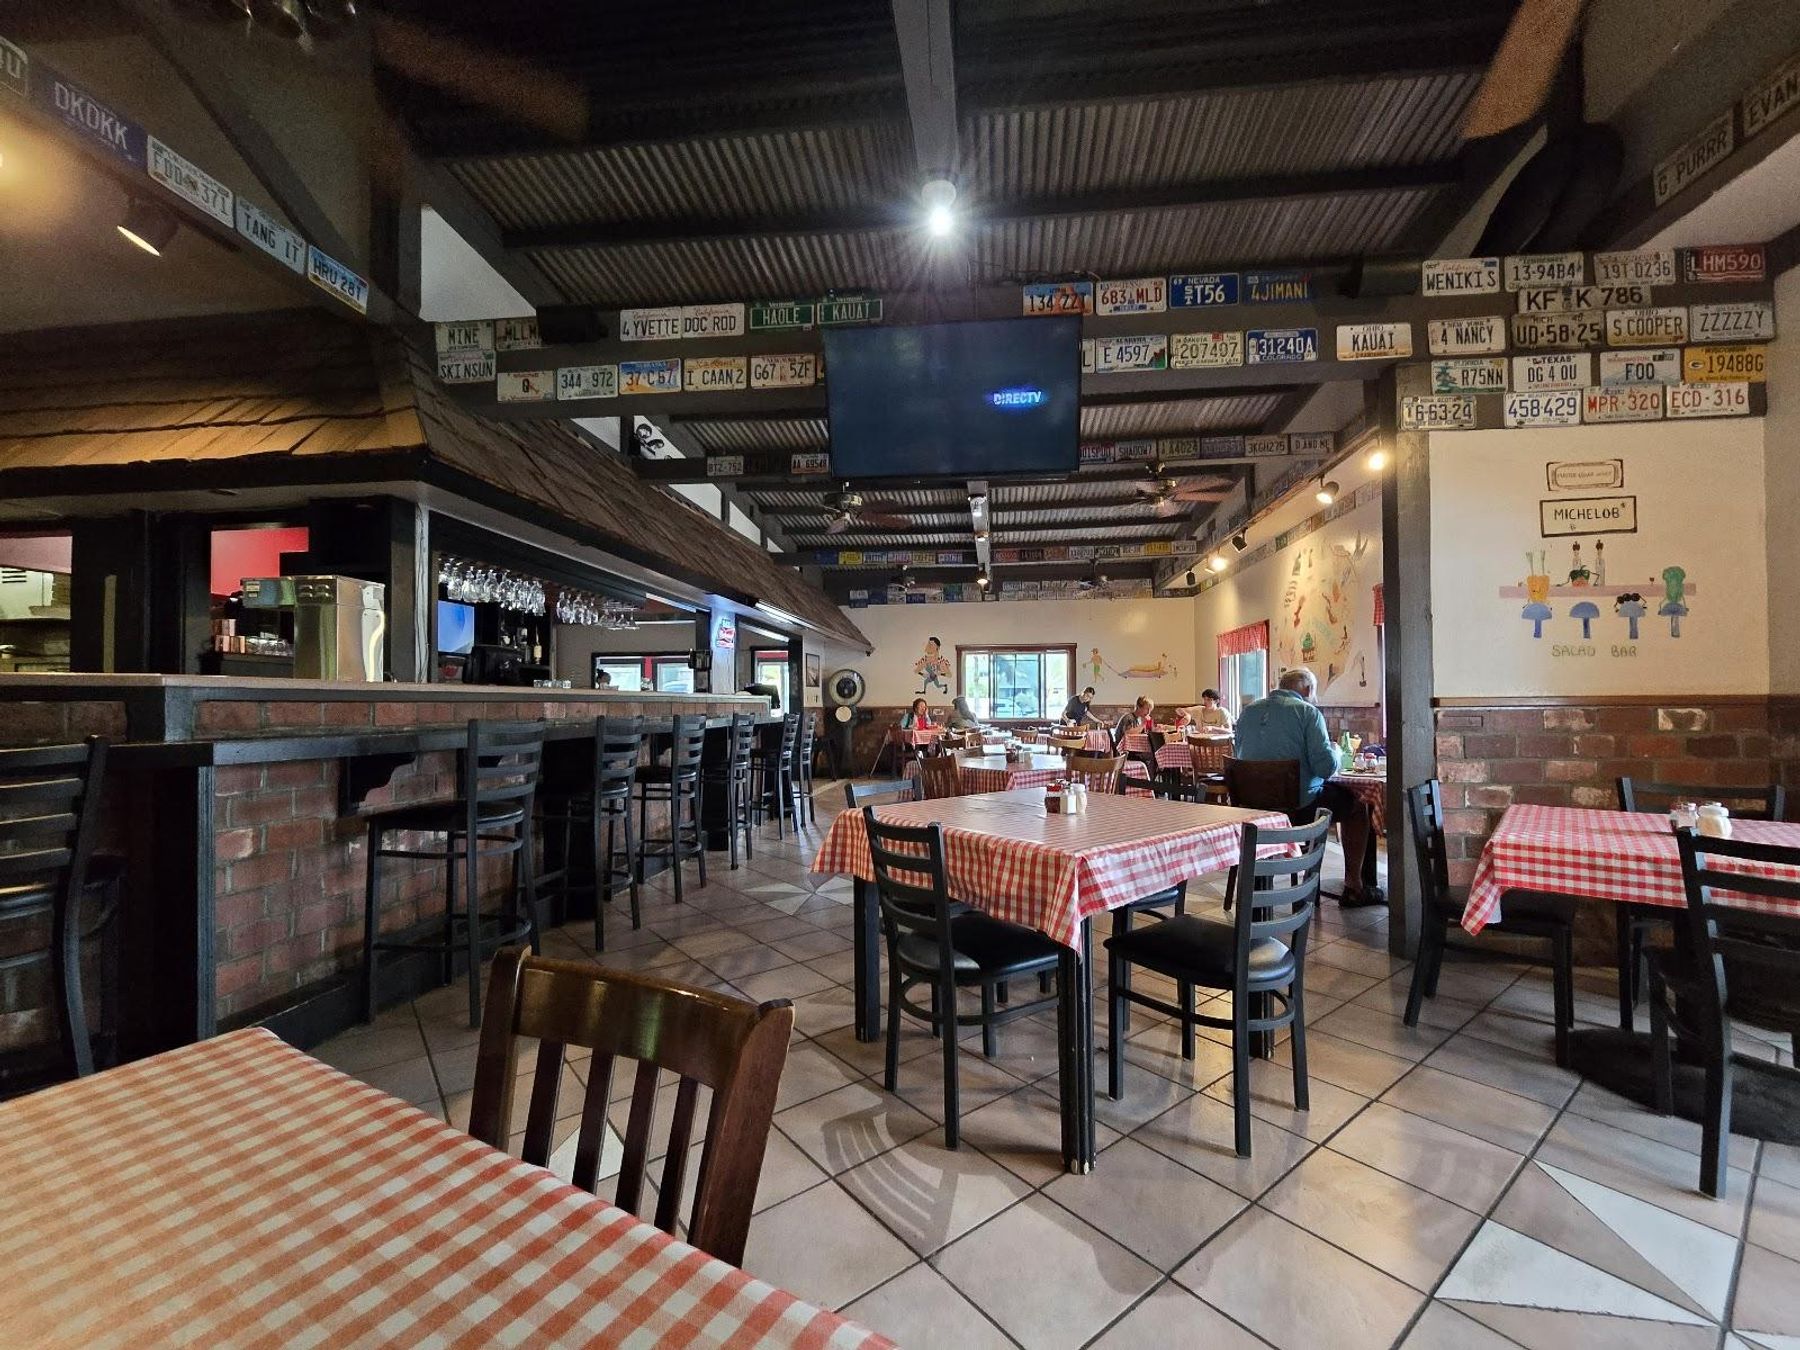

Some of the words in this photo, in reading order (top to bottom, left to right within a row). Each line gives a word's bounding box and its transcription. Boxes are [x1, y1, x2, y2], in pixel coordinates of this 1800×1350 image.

[244, 212, 276, 249] TANG
[285, 243, 300, 264] IT
[313, 258, 338, 285] HRU
[1188, 276, 1220, 285] NEVADA
[1102, 290, 1127, 305] 683
[1136, 286, 1163, 304] MLD
[1194, 284, 1225, 305] T56
[1526, 290, 1557, 311] KF
[1576, 289, 1592, 308] K
[1601, 286, 1643, 306] 786
[622, 321, 630, 337] 4
[633, 319, 680, 337] YVETTE
[684, 318, 708, 333] DOC
[713, 315, 736, 332] ROD
[1613, 318, 1622, 337] S
[1627, 316, 1683, 337] COOPER
[1352, 332, 1395, 352] KAUAI
[1441, 328, 1448, 345] 4
[1455, 326, 1493, 346] NANCY
[1103, 347, 1112, 364] E
[1116, 345, 1151, 364] 4597
[1258, 336, 1314, 356] 31240A
[1541, 355, 1572, 364] TEXAS
[1707, 353, 1764, 374] 19488G
[561, 373, 582, 390] 344
[592, 371, 614, 388] 972
[754, 363, 776, 381] G67
[1461, 368, 1503, 386] R75NN
[1548, 365, 1555, 382] 4
[1625, 362, 1655, 381] FOO
[993, 391, 1042, 405] DIRECTV
[1553, 507, 1620, 521] MICHELOB
[1611, 643, 1638, 658] BAR
